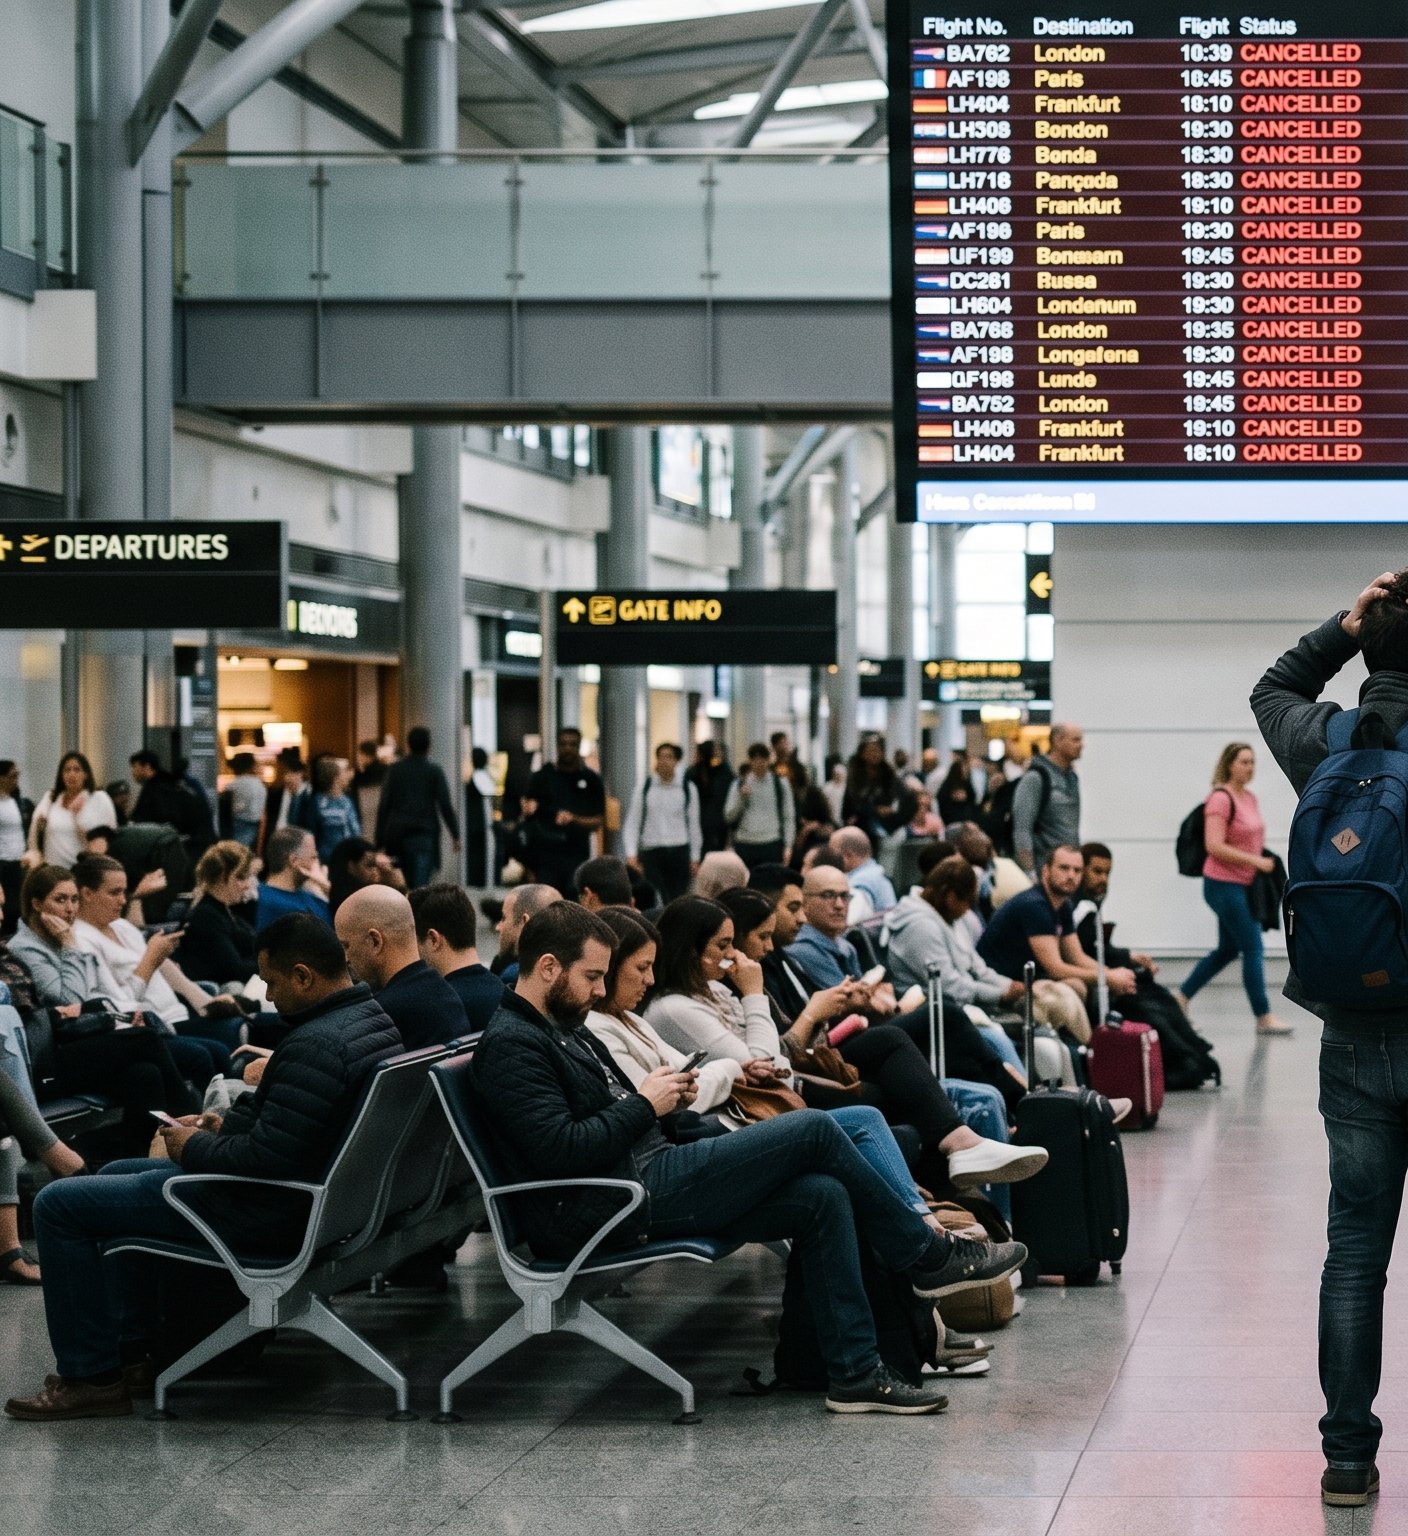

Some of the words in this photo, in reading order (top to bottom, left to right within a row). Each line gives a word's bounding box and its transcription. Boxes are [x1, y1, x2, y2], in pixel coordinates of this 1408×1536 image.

[924, 17, 973, 39] Flight
[976, 17, 1007, 35] No.
[1034, 17, 1133, 35] Destination
[1180, 17, 1229, 39] Flight
[1240, 17, 1297, 35] Status
[1035, 45, 1105, 62] London
[1241, 44, 1361, 61] CANCELLED
[1035, 70, 1084, 87] Paris
[1241, 70, 1361, 87] CANCELLED
[1035, 95, 1120, 112] Frankfurt
[1241, 95, 1361, 112] CANCELLED
[1036, 121, 1108, 138] Bondon
[1181, 121, 1233, 138] 19:30
[1241, 121, 1361, 138] CANCELLED
[1036, 146, 1096, 163] Bonda
[1181, 146, 1233, 163] 18:30
[1241, 146, 1361, 163] CANCELLED
[1182, 172, 1233, 188] 18:30
[1241, 171, 1361, 188] CANCELLED
[1037, 197, 1121, 214] Frankfurt
[1182, 197, 1233, 214] 19:10
[1241, 197, 1361, 214] CANCELLED
[1037, 222, 1085, 239] Paris
[1182, 222, 1233, 239] 19:30
[1242, 222, 1361, 238] CANCELLED
[1182, 247, 1234, 264] 19:45
[1242, 247, 1361, 264] CANCELLED
[1182, 272, 1234, 288] 19:30
[1242, 272, 1361, 288] CANCELLED
[1183, 296, 1234, 313] 19:30
[1242, 296, 1361, 313] CANCELLED
[1038, 321, 1107, 338] London
[1183, 321, 1234, 338] 19:35
[1243, 321, 1361, 338] CANCELLED
[1183, 346, 1234, 362] 19:30
[1243, 346, 1361, 362] CANCELLED
[1039, 371, 1096, 387] Lunde
[1183, 371, 1235, 387] 19:45
[1243, 371, 1361, 387] CANCELLED
[1039, 395, 1108, 412] London
[1184, 395, 1235, 412] 19:45
[1243, 395, 1362, 412] CANCELLED
[1040, 420, 1124, 436] Frankfurt
[1184, 420, 1235, 436] 19:10
[1243, 420, 1362, 436] CANCELLED
[1040, 444, 1124, 461] Frankfurt
[1243, 444, 1362, 461] CANCELLED
[55, 534, 228, 559] DEPARTURES
[619, 600, 669, 621] GATE
[674, 600, 721, 620] INFO
